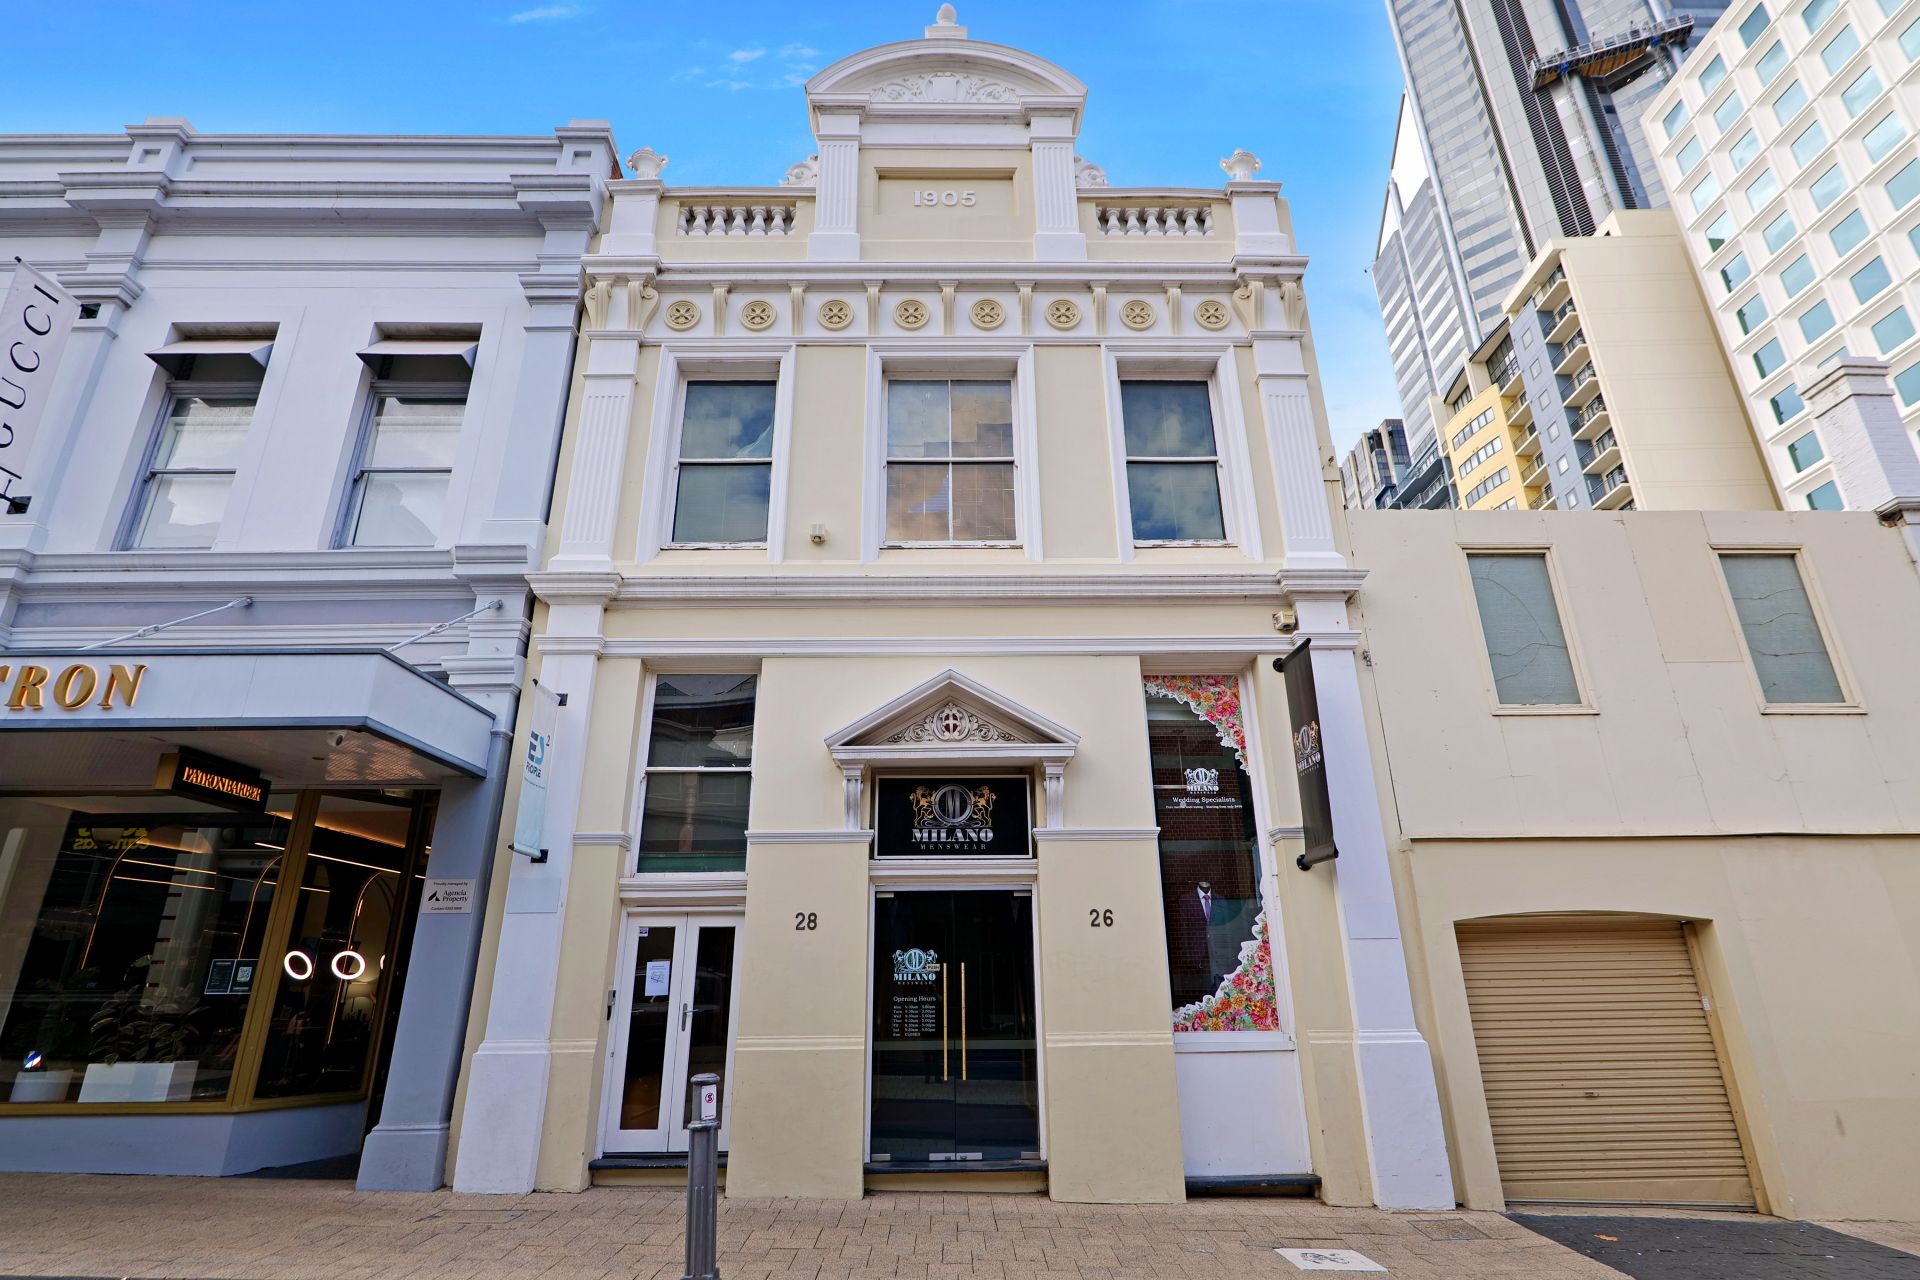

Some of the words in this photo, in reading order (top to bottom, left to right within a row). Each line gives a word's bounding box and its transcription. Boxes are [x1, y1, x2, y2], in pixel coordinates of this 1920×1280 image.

[913, 190, 977, 208] 1905
[0, 664, 148, 710] RON
[911, 828, 994, 842] MILANO
[795, 912, 818, 931] 28
[1089, 909, 1114, 927] 26
[893, 973, 937, 981] MILANO
